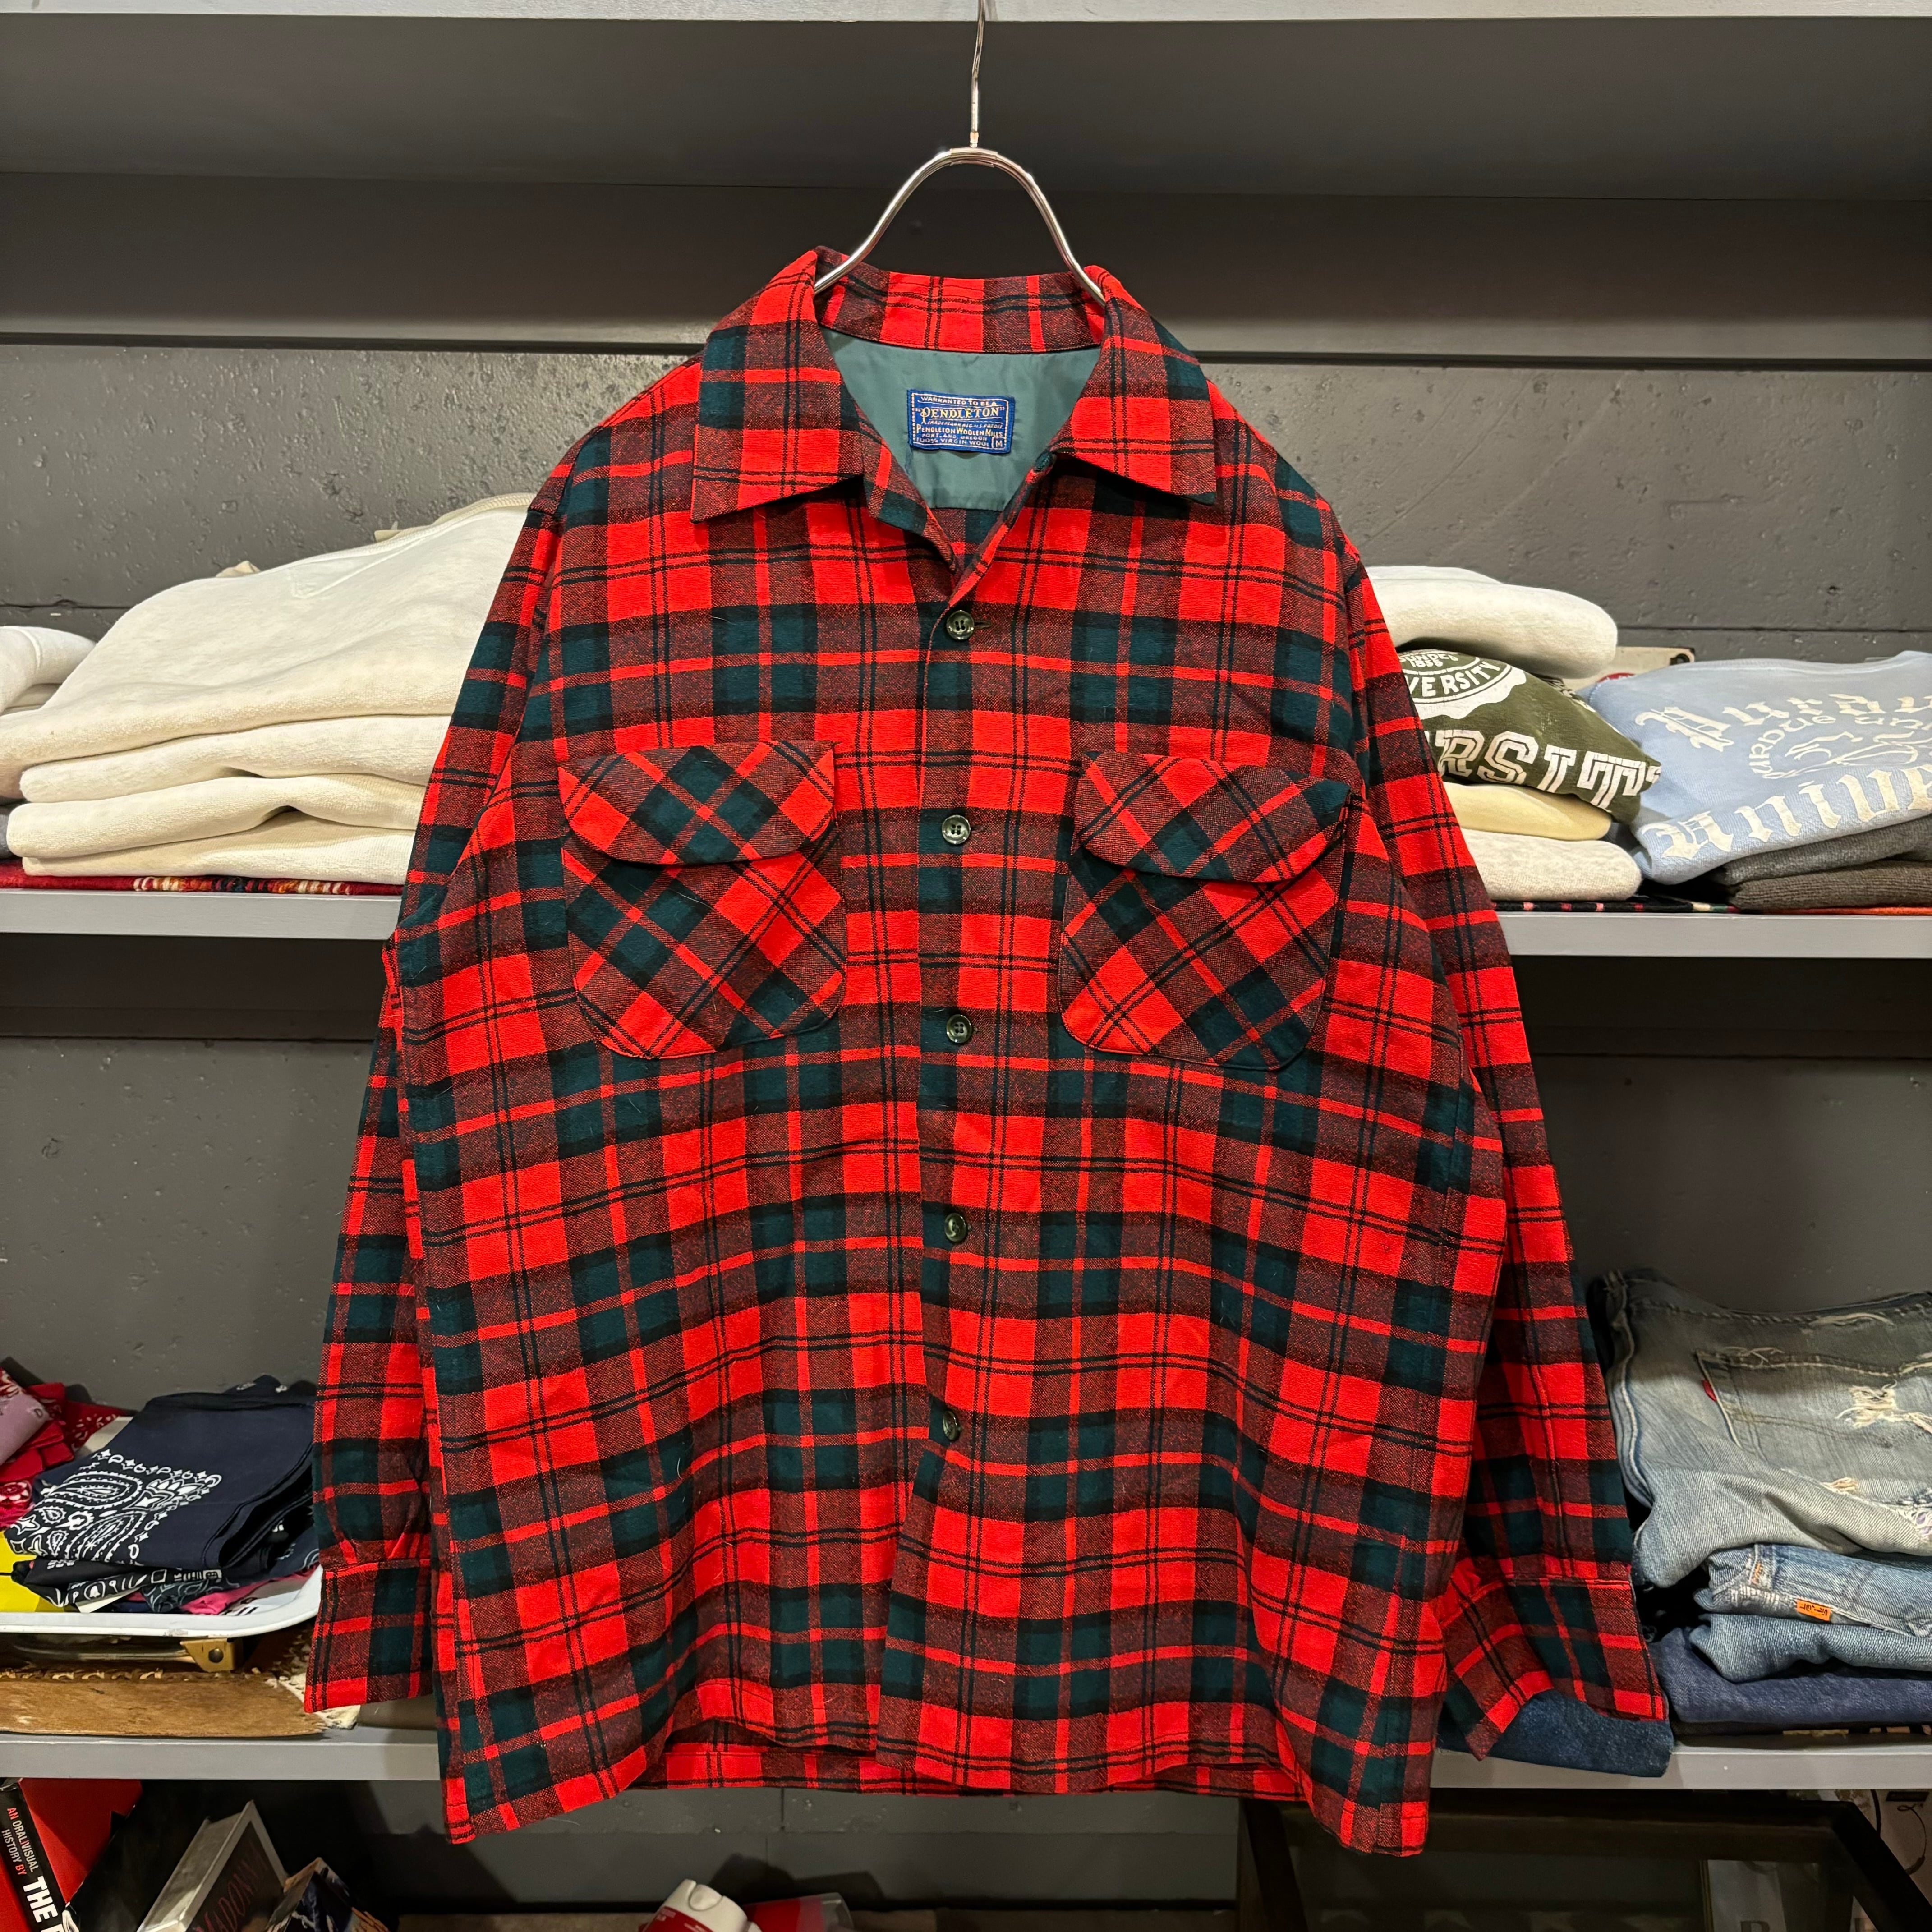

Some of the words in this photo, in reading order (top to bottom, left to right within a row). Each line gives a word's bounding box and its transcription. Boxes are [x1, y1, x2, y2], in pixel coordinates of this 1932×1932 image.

[921, 397, 966, 405] WARRANTED
[916, 424, 956, 434] PENDLETON
[956, 427, 984, 436] WOOLEN
[985, 429, 1003, 437] MILLS
[7, 1807, 19, 1820] AN
[1, 1829, 22, 1863] HISTORY
[15, 1864, 27, 1875] BY
[23, 1876, 58, 1923] THE
